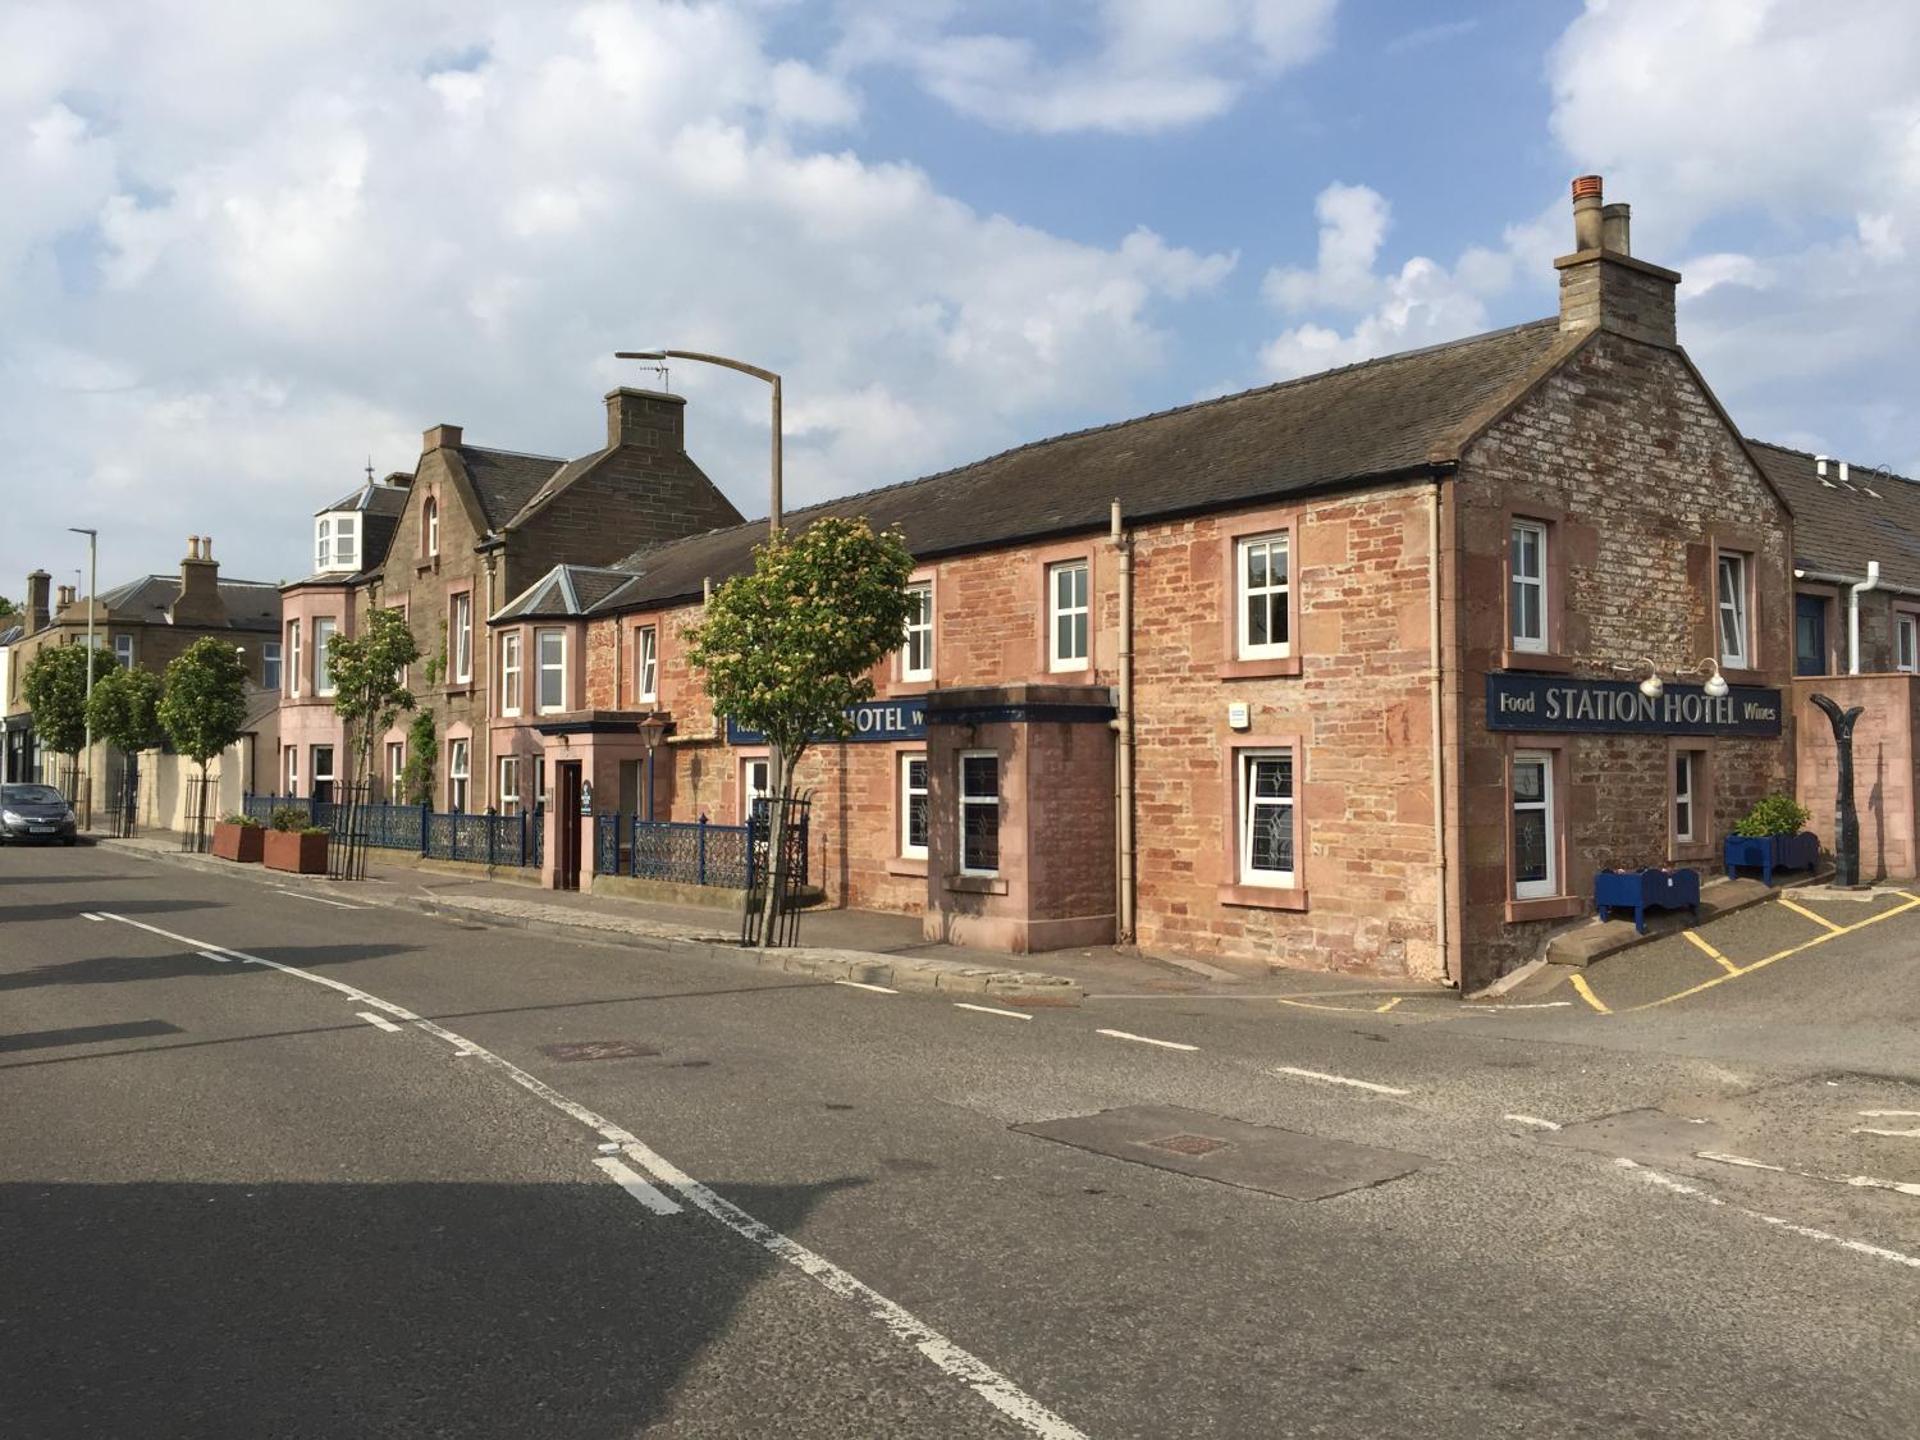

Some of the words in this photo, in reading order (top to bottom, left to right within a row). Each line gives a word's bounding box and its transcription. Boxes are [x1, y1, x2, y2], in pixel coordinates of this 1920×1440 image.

[1500, 691, 1536, 713] Food
[1546, 688, 1656, 722] STATION
[1664, 694, 1739, 724] HOTEL
[1743, 702, 1777, 721] Wines
